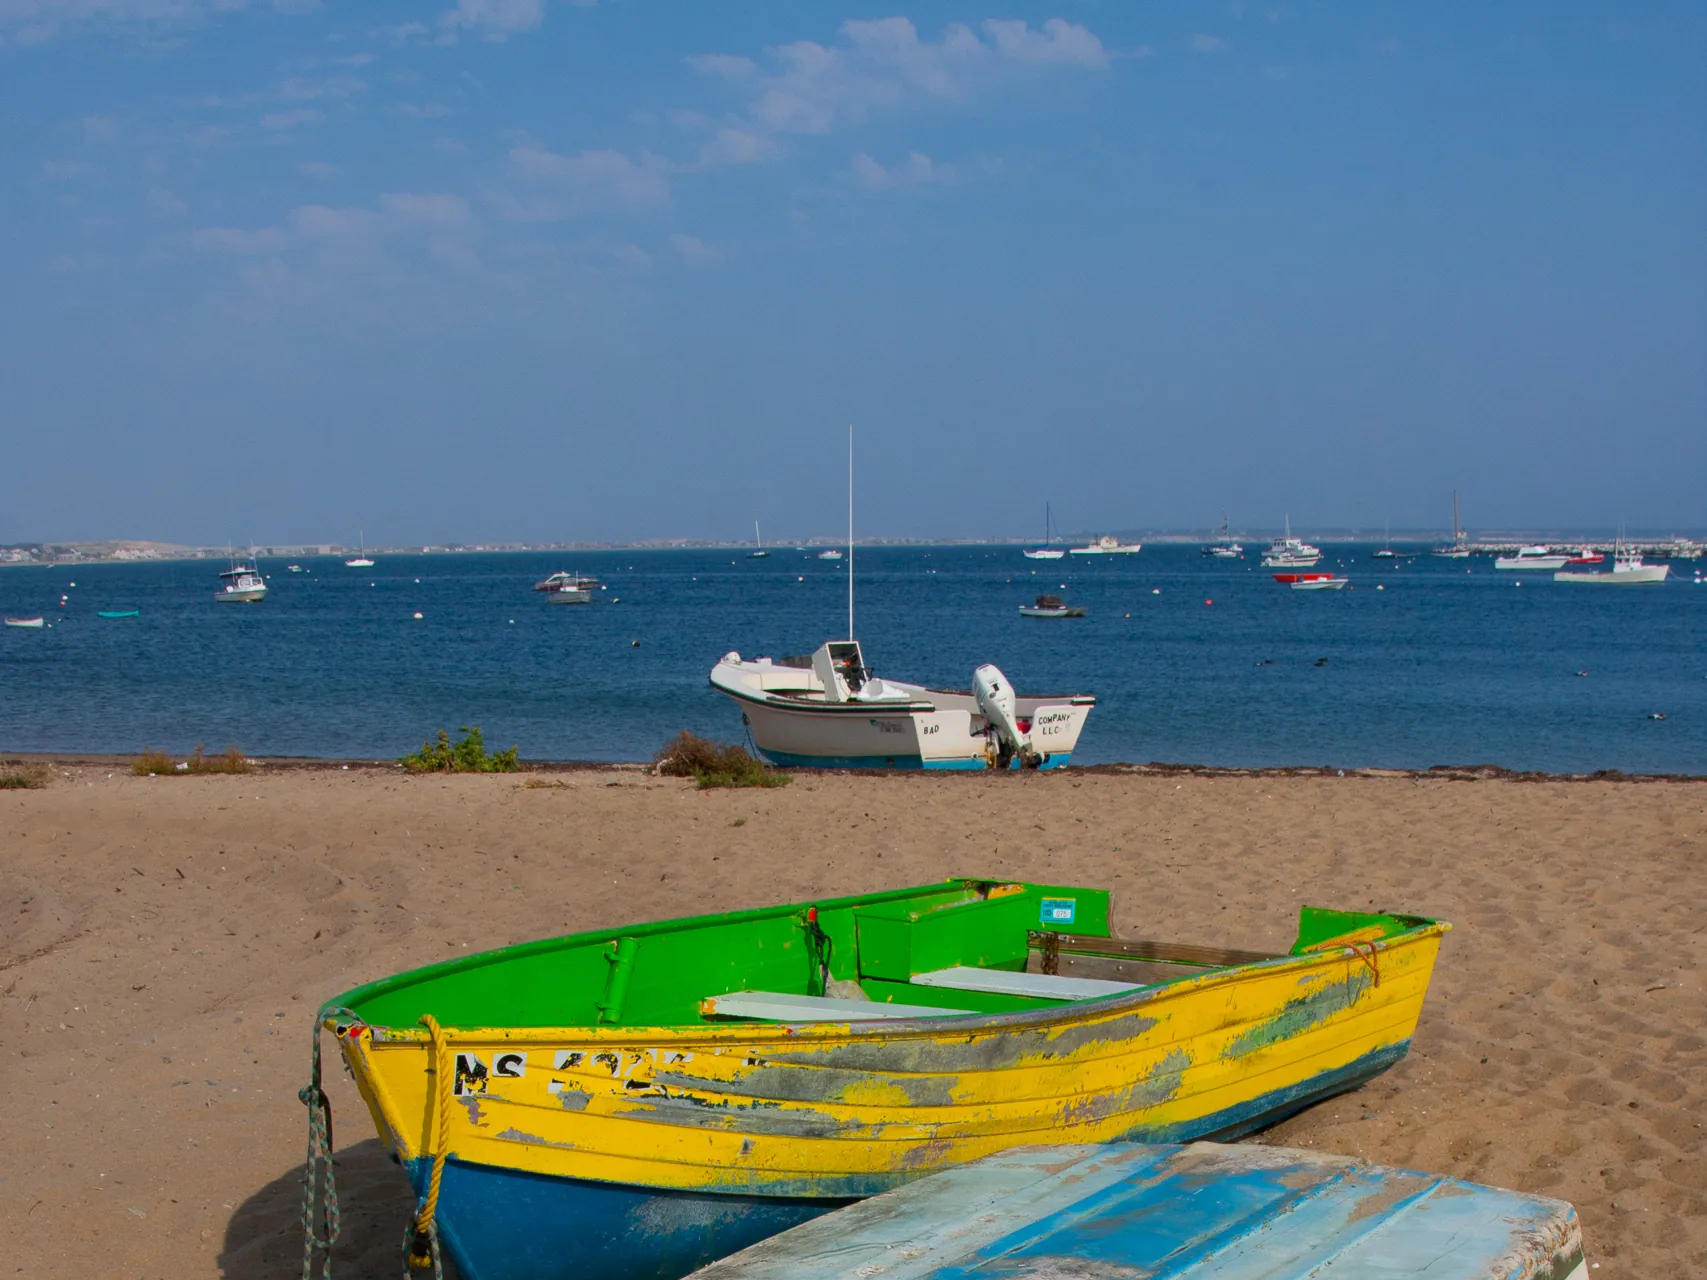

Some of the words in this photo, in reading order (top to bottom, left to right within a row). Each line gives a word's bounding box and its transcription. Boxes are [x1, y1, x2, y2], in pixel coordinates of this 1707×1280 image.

[1038, 713, 1071, 725] COMPANY
[923, 724, 939, 735] BAD
[1042, 726, 1059, 735] LLC
